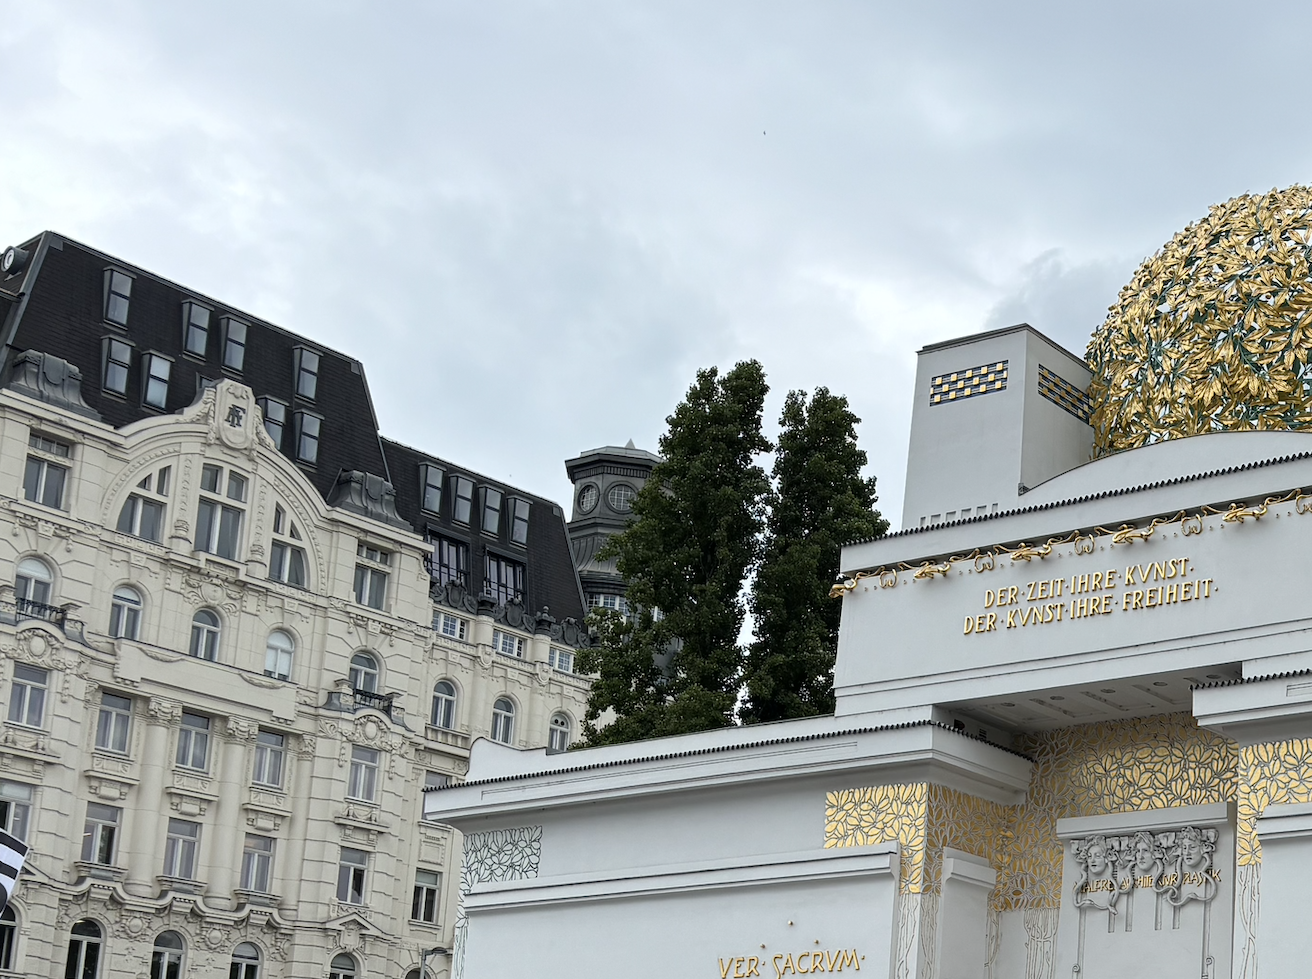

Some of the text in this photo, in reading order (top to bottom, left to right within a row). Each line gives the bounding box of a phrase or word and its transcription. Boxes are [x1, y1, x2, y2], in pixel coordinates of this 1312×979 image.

[1026, 577, 1066, 602] ZEIT
[1070, 569, 1117, 595] IHRE
[1070, 593, 1113, 619] IHRE
